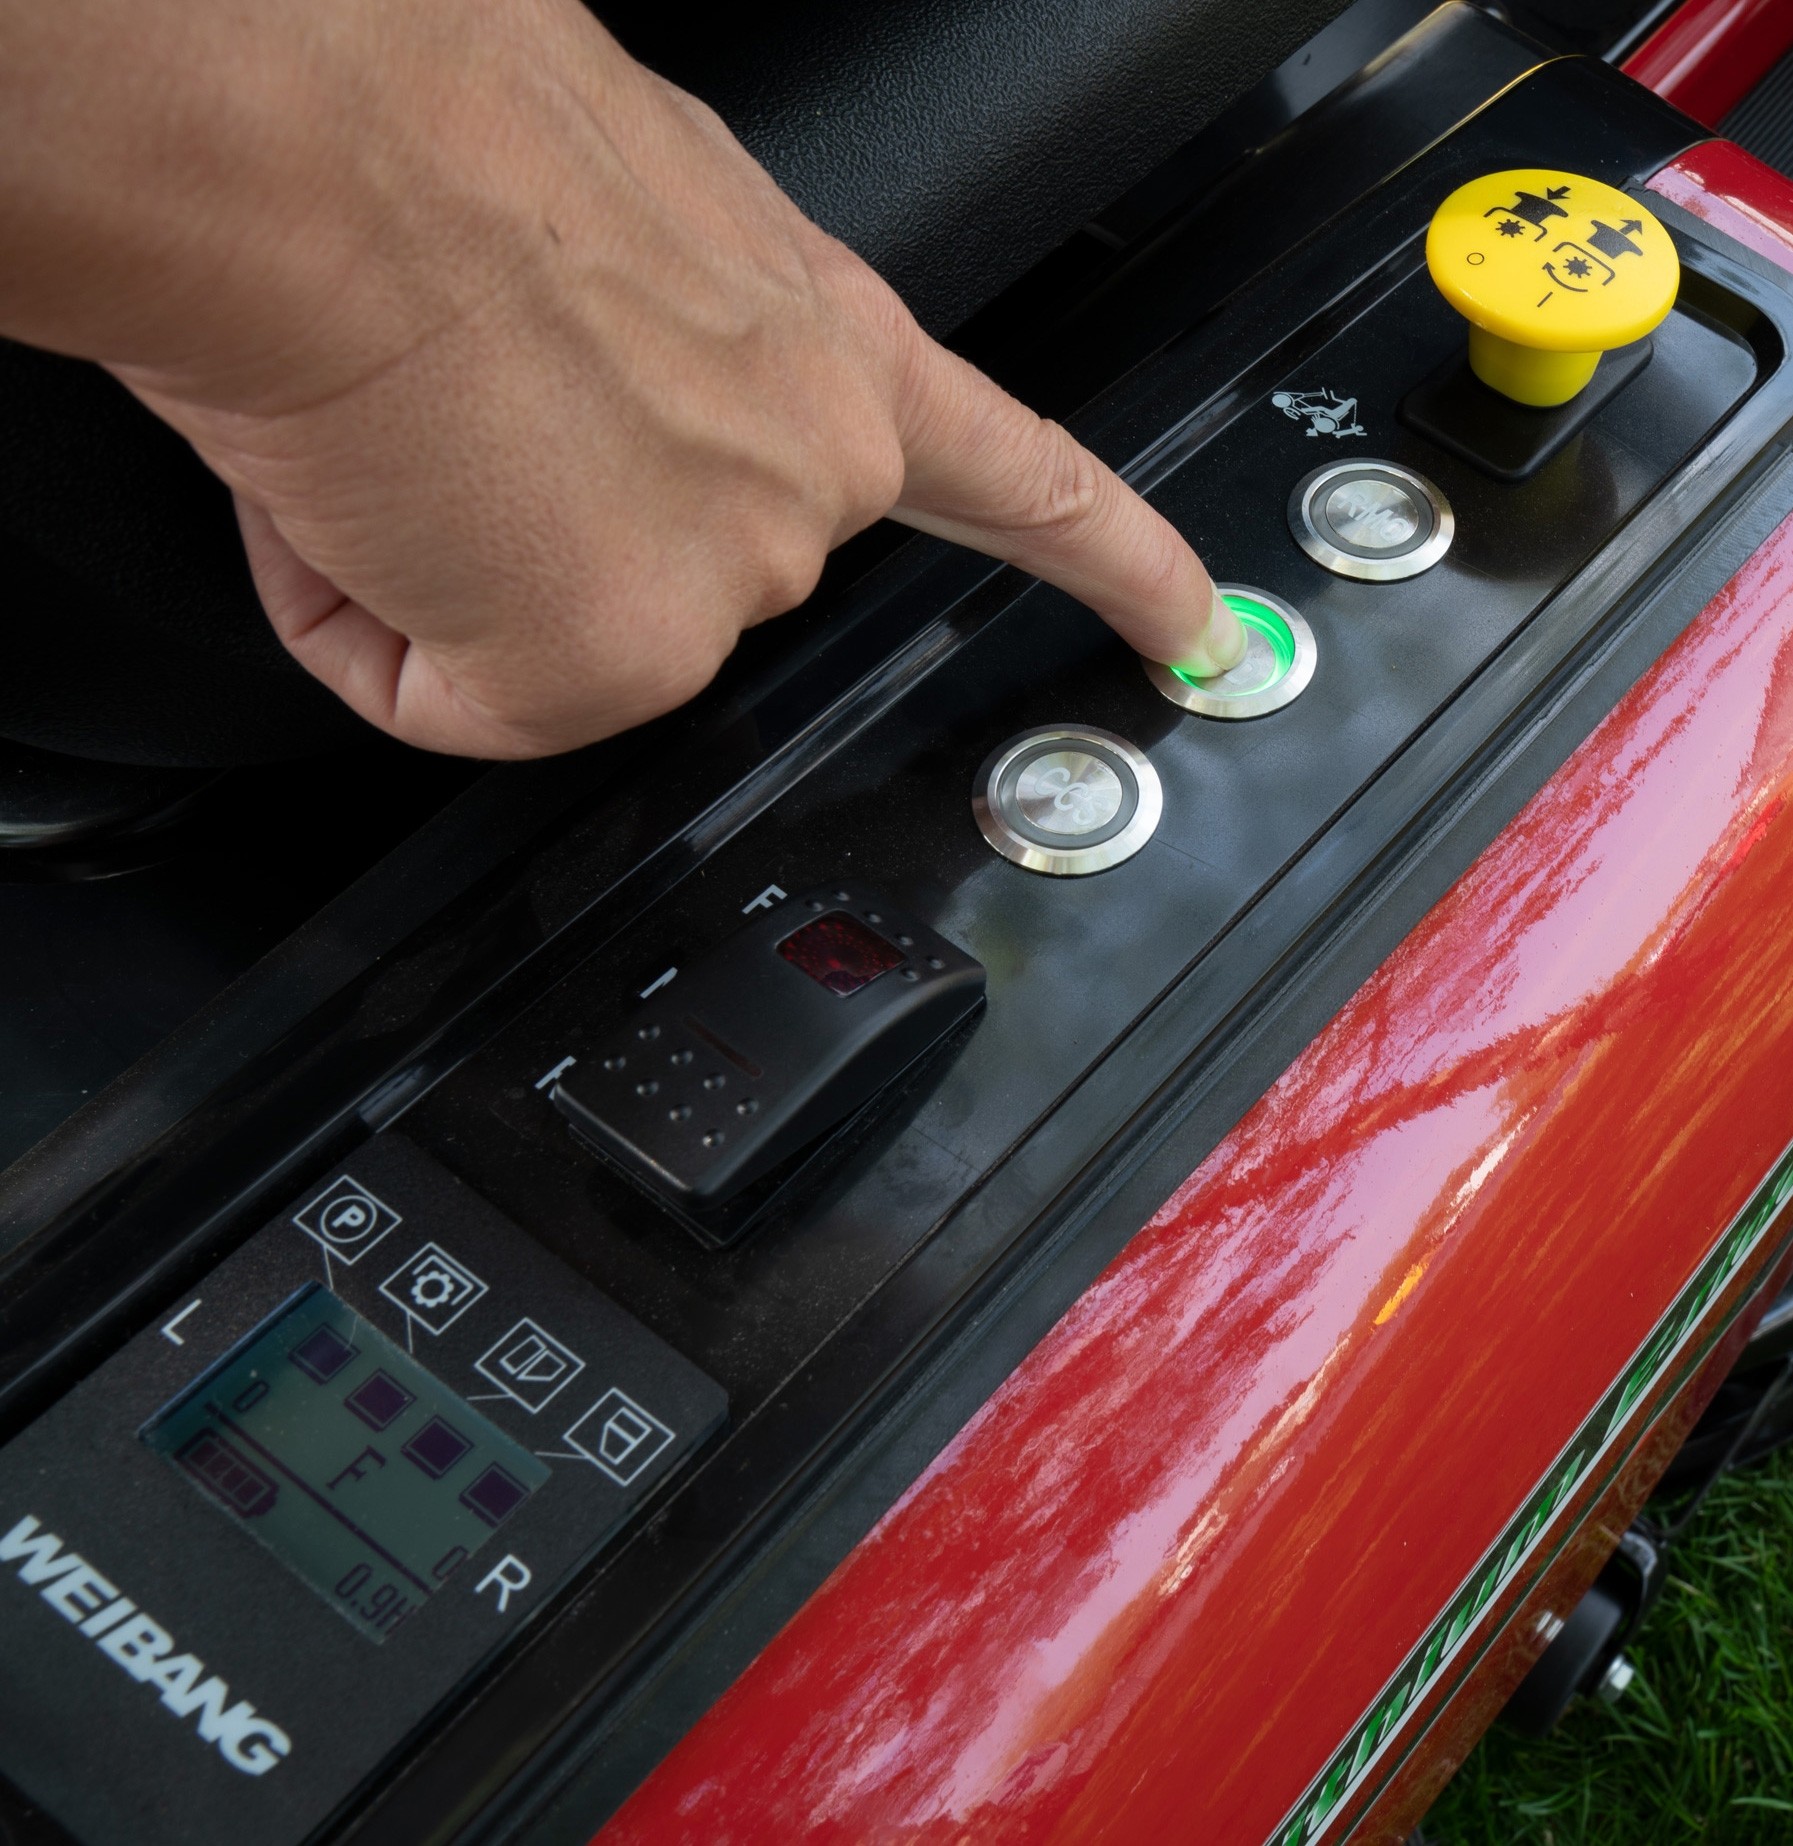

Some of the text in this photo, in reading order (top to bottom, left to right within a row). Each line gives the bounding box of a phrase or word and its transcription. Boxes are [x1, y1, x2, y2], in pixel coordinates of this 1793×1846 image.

[1034, 766, 1111, 826] CCS
[331, 1204, 366, 1228] P
[161, 1299, 201, 1344] L
[327, 1445, 387, 1490] F
[475, 1554, 531, 1611] R
[0, 1514, 291, 1776] WEIBANG
